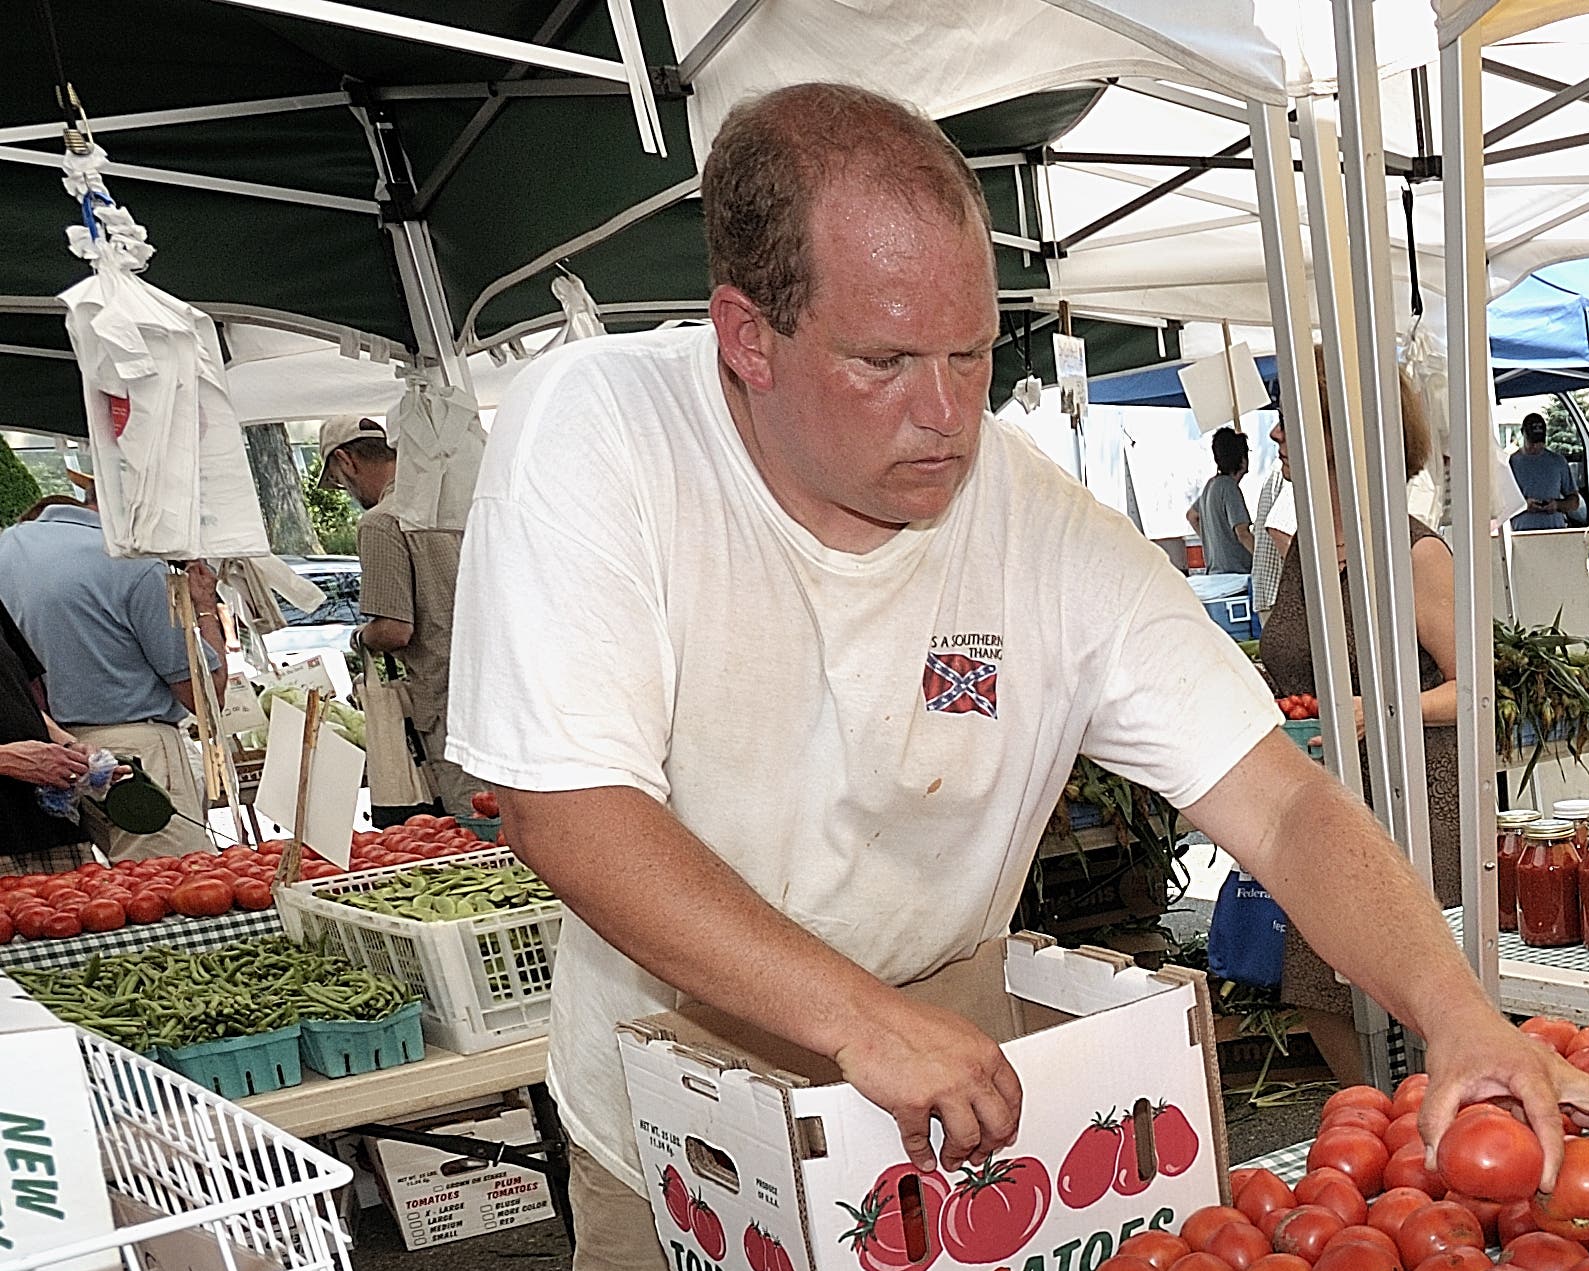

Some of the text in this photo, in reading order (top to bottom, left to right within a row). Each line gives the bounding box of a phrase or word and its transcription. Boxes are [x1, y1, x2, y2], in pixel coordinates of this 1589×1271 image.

[941, 637, 949, 648] A
[951, 634, 1003, 648] SOUTHERN
[969, 647, 1003, 660] THANG
[0, 1111, 65, 1220] NEW
[494, 1176, 522, 1189] PLUM
[487, 1182, 539, 1200] TOMATOES
[405, 1191, 460, 1209] TOMATOES
[438, 1203, 465, 1214] LARGE
[497, 1200, 548, 1218] MORE COLOR
[428, 1214, 453, 1225] LARGE
[430, 1220, 463, 1233] MEDIUM
[432, 1231, 458, 1242] SMALL
